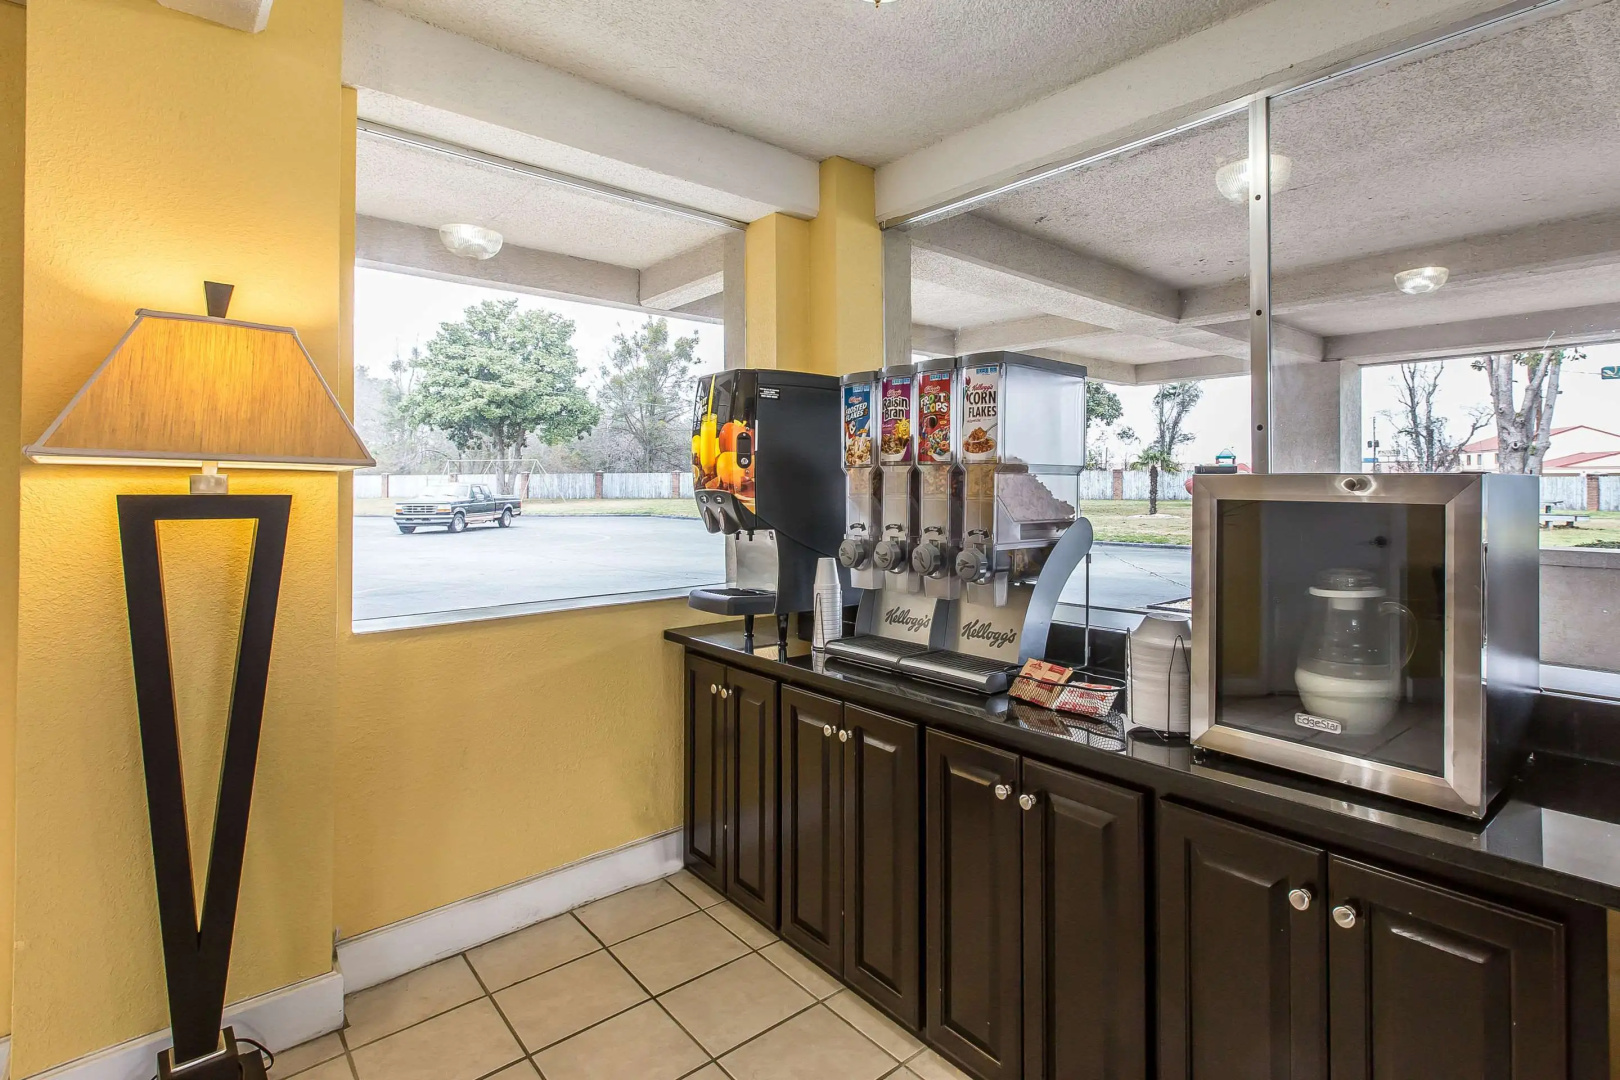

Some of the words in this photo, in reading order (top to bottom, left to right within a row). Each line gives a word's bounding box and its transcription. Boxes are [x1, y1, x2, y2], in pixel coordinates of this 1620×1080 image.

[971, 382, 993, 392] Kellogg's
[882, 396, 909, 410] Raisin
[968, 391, 997, 405] CORN
[883, 408, 905, 420] Bran
[923, 402, 948, 414] LOOPS
[968, 405, 997, 418] FLAKES
[884, 606, 931, 633] Kellogg's
[961, 619, 1017, 648] Kellogg's
[1297, 714, 1339, 731] EdgeStar
